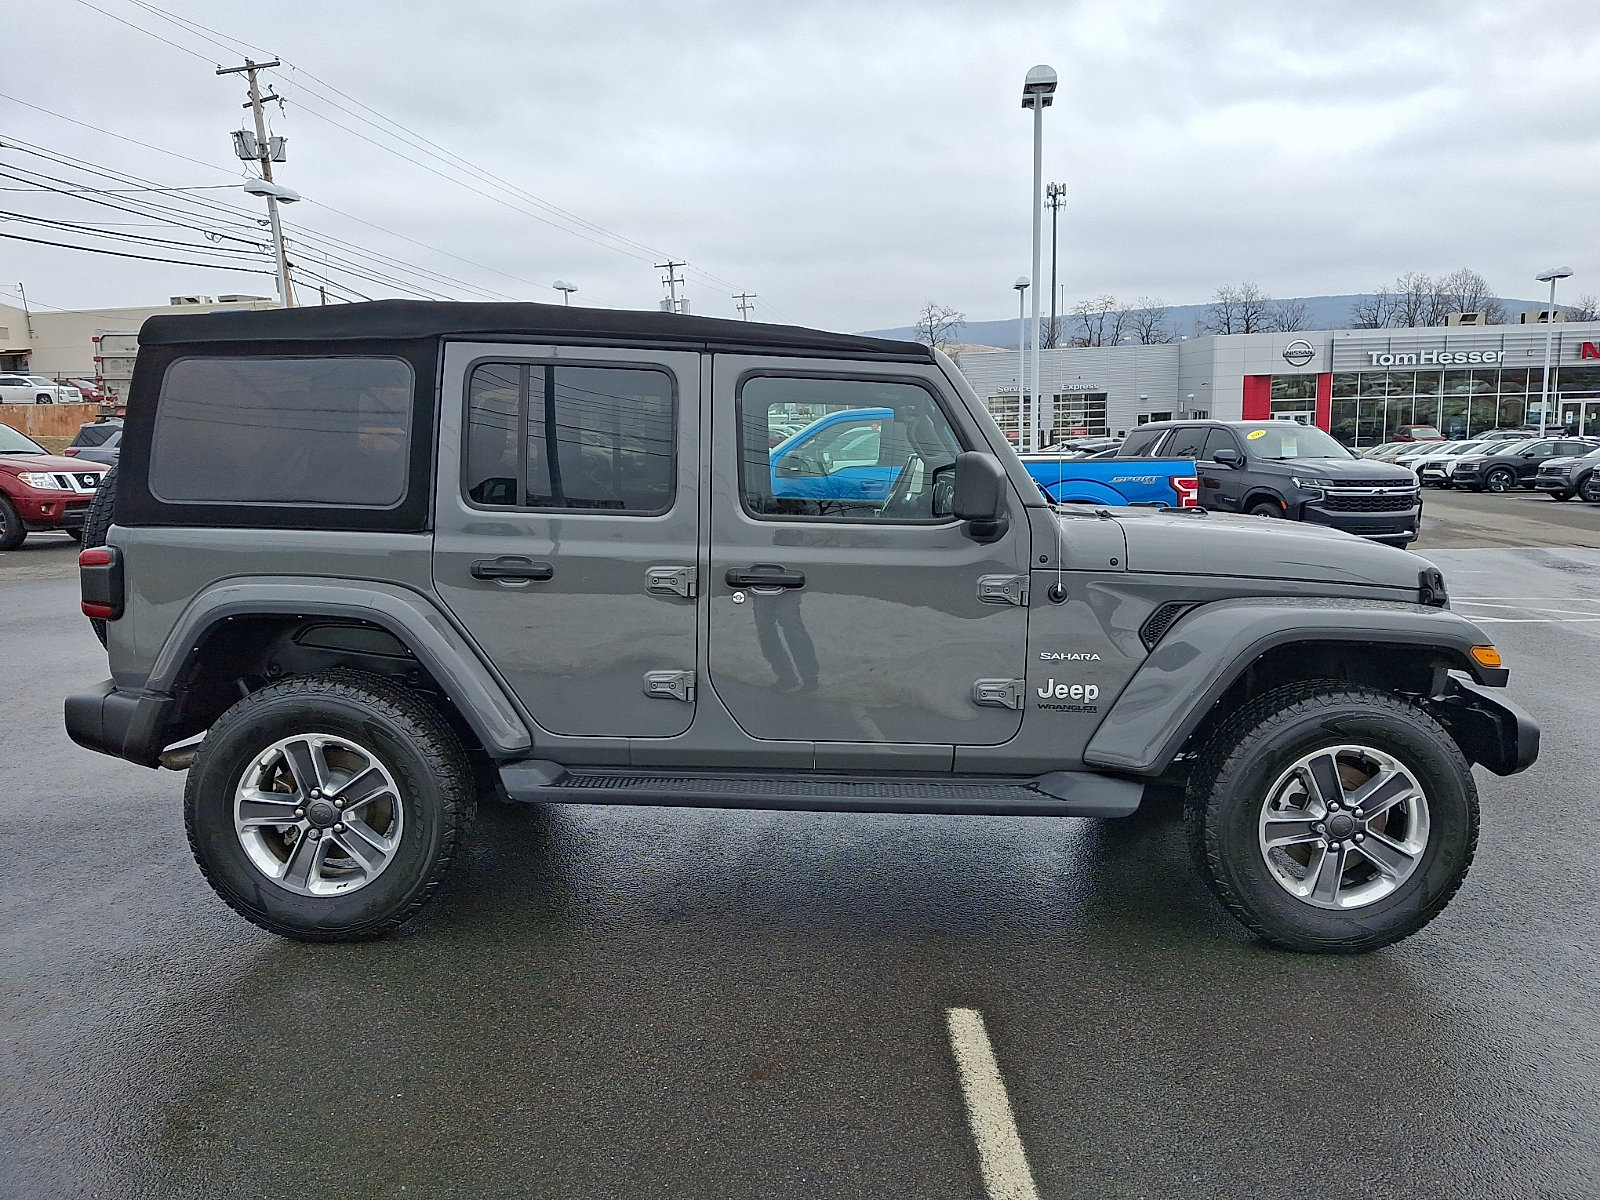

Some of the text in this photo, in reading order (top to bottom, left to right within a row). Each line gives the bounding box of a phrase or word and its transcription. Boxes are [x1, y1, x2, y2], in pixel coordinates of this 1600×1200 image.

[1368, 349, 1506, 366] Tom Hesser
[1062, 383, 1099, 391] Express
[1040, 652, 1101, 661] SAHARA
[1037, 678, 1099, 704] Jeep
[1037, 703, 1097, 711] WRANGLER
